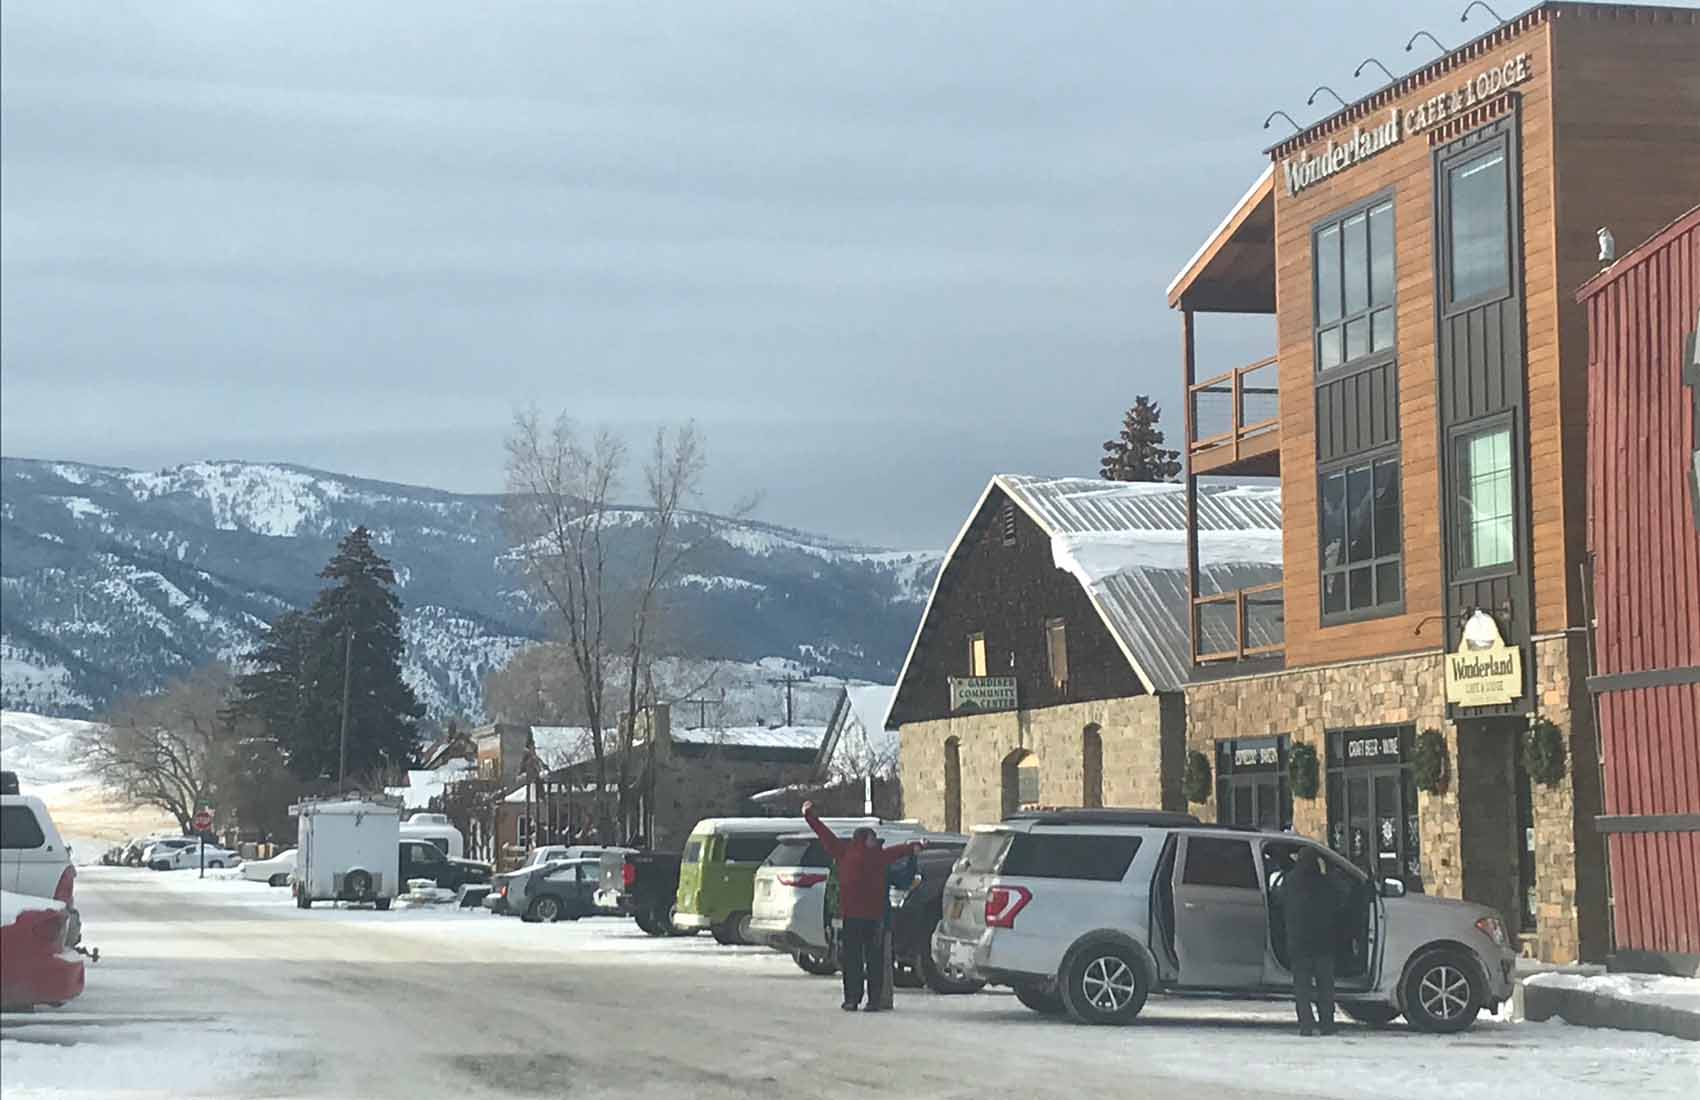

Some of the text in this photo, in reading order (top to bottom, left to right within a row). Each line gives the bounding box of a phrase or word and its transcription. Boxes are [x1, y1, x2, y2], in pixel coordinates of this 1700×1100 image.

[1282, 107, 1399, 196] Wonderland
[1404, 93, 1446, 134] CAFE
[1466, 53, 1527, 107] LODGE
[1452, 653, 1514, 681] Wonderland
[959, 688, 1014, 699] COMMUNITY
